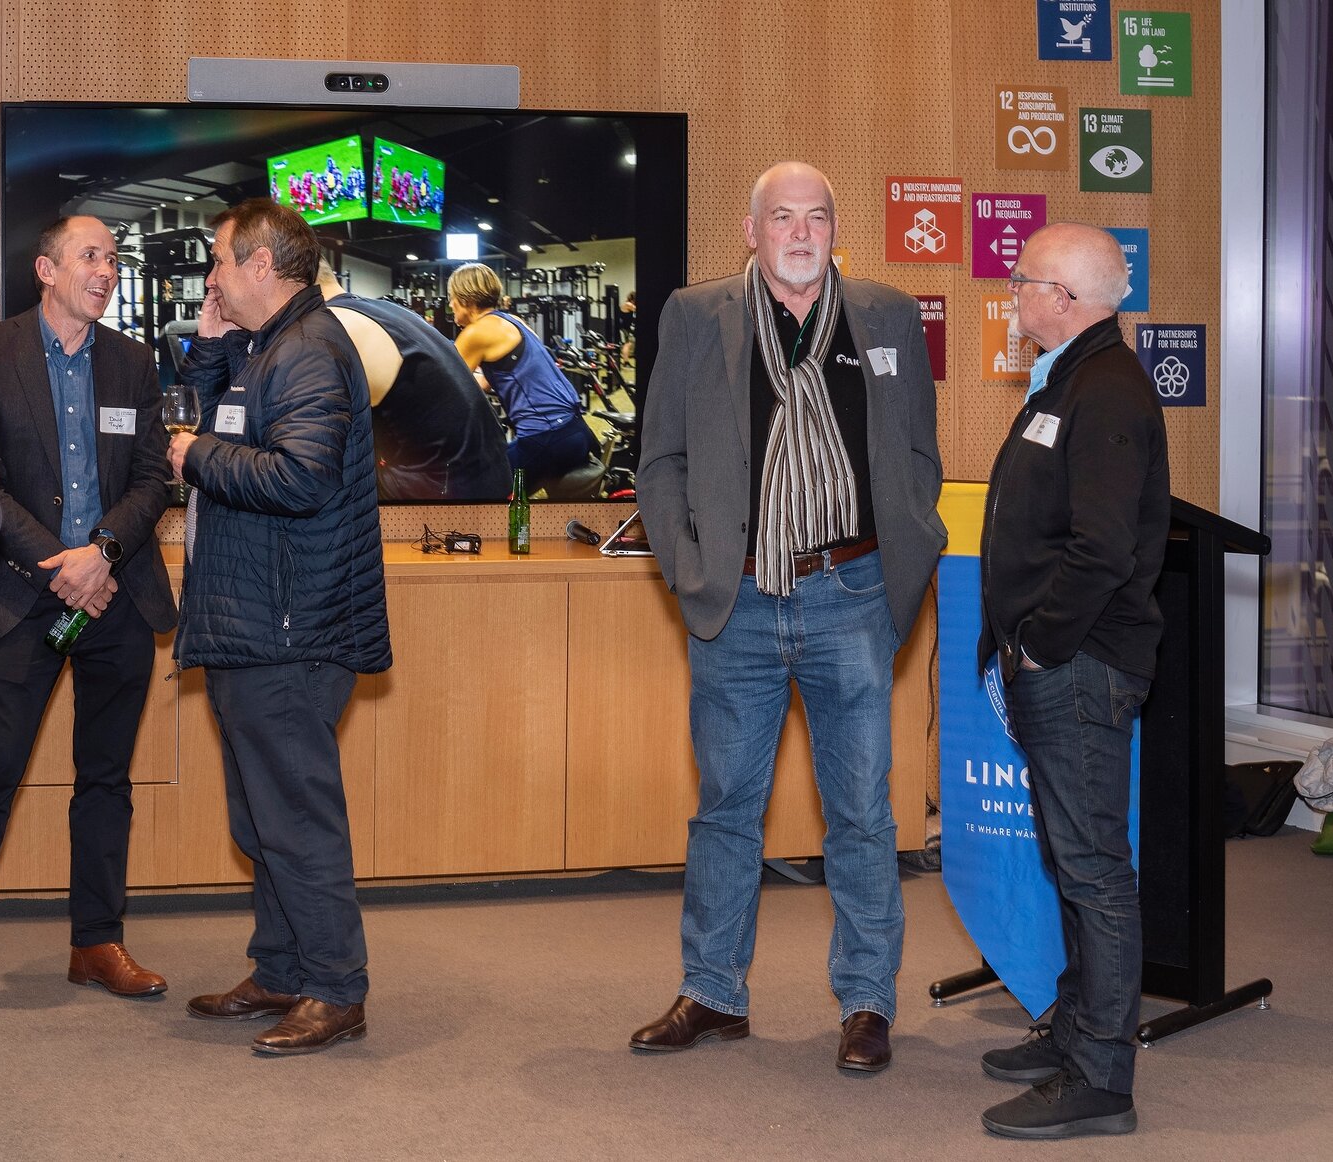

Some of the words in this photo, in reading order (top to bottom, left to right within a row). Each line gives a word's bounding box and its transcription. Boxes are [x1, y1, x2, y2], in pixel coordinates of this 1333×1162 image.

[1059, 3, 1097, 12] INSTITUTIONS
[1123, 17, 1138, 36] 15
[1141, 18, 1152, 26] LIFE
[1141, 28, 1150, 36] ON
[1151, 28, 1166, 37] LAND
[999, 91, 1014, 110] 12
[1017, 92, 1053, 101] RESPONSIBLE
[1017, 102, 1056, 111] CONSUMPTION
[1018, 112, 1030, 120] AND
[1030, 112, 1065, 121] PRODUCTION
[1100, 115, 1124, 124] CLIMATE
[1083, 114, 1098, 133] 13
[1100, 124, 1122, 134] ACTION
[891, 182, 901, 202] 9
[903, 183, 930, 193] INDUSTRY,
[931, 184, 962, 193] INNOVATION
[903, 193, 915, 202] AND
[916, 194, 962, 203] INFRASTRUCTURE
[976, 199, 992, 219] 10
[995, 200, 1021, 209] REDUCED
[995, 210, 1032, 219] INEQUALITIES
[929, 301, 942, 310] AND
[1000, 301, 1014, 310] SUS
[986, 301, 998, 320] 11
[1158, 330, 1197, 339] PARTNERSHIPS
[1141, 330, 1154, 349] 17
[1158, 340, 1169, 349] FOR
[1169, 340, 1180, 349] THE
[1180, 340, 1198, 349] GOALS
[988, 680, 1005, 715] SCIENTIA
[965, 822, 975, 832] TE
[977, 824, 1012, 838] WHARE
